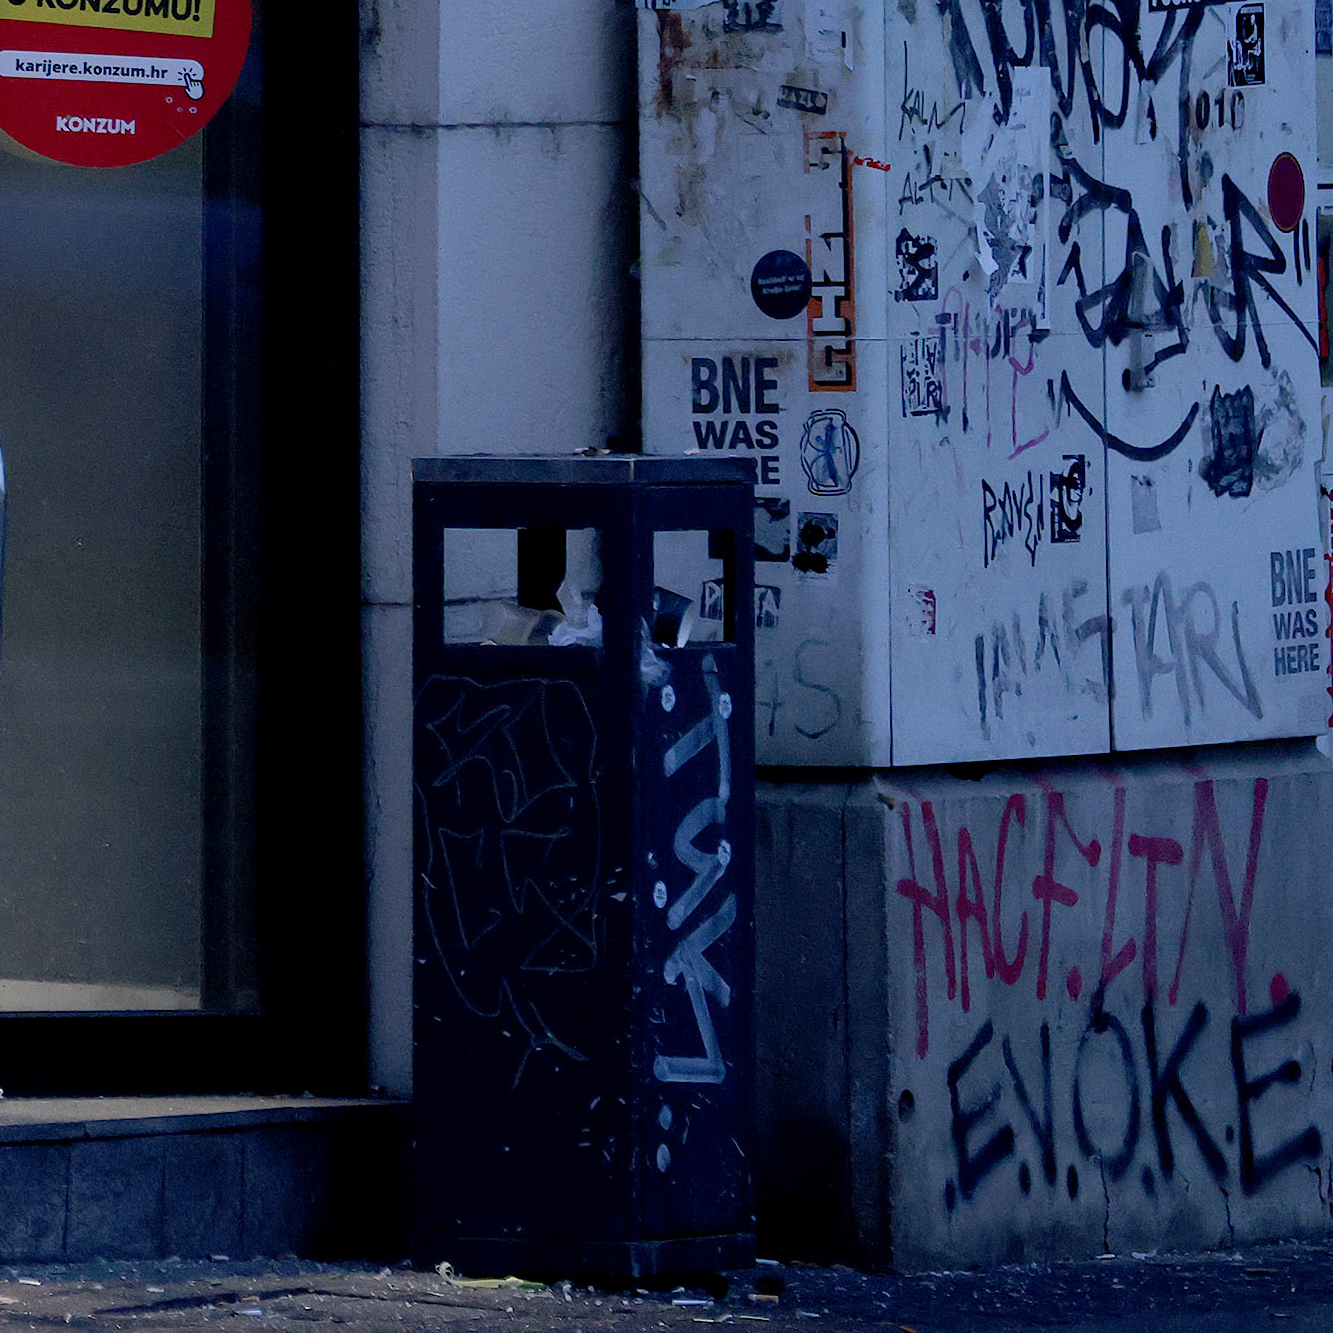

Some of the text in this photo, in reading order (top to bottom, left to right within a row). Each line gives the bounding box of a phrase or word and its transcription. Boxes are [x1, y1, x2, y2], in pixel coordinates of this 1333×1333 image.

[15, 59, 168, 80] karijere.konzum.hr
[56, 116, 136, 135] KONZUM
[691, 357, 779, 414] BNE
[692, 421, 780, 449] WAS
[1270, 548, 1317, 607] BNE
[1273, 609, 1319, 641] WAS
[1274, 643, 1320, 676] HERE
